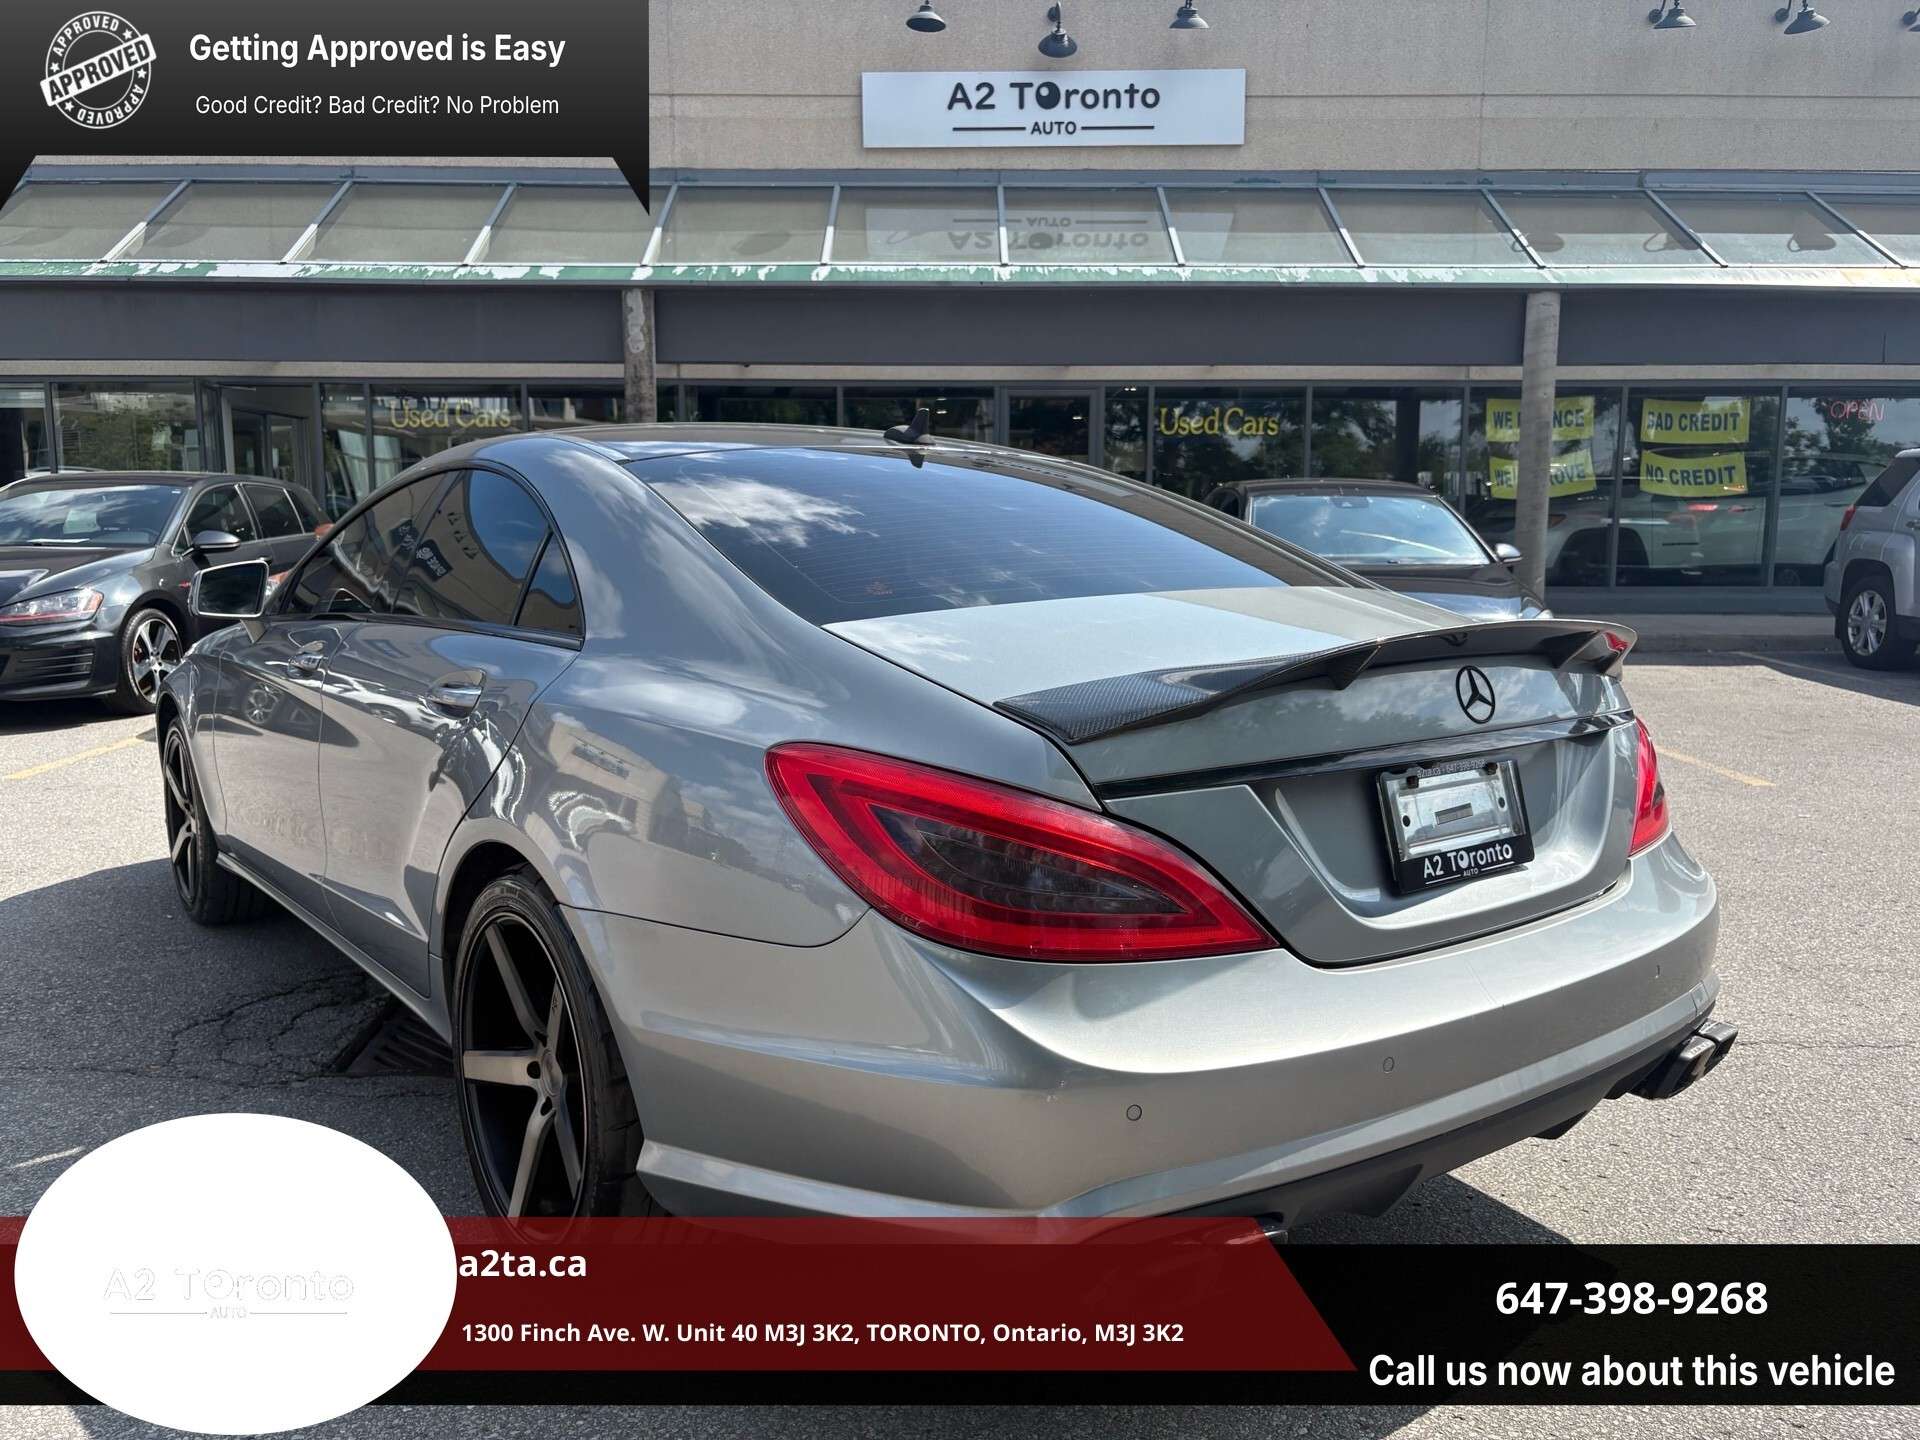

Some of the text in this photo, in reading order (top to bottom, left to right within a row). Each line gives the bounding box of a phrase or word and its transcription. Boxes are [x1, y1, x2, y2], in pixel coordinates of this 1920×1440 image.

[947, 81, 996, 111] A2
[1030, 120, 1077, 136] AUTO
[389, 399, 511, 428] Used Cars
[1493, 411, 1513, 429] WE
[1831, 400, 1886, 421] OPEN
[1159, 407, 1280, 437] Used Cars
[1647, 411, 1740, 432] BAD CREDIT
[1646, 464, 1736, 486] NO CREDIT
[1424, 855, 1445, 878] A2
[1463, 867, 1479, 877] AUTO
